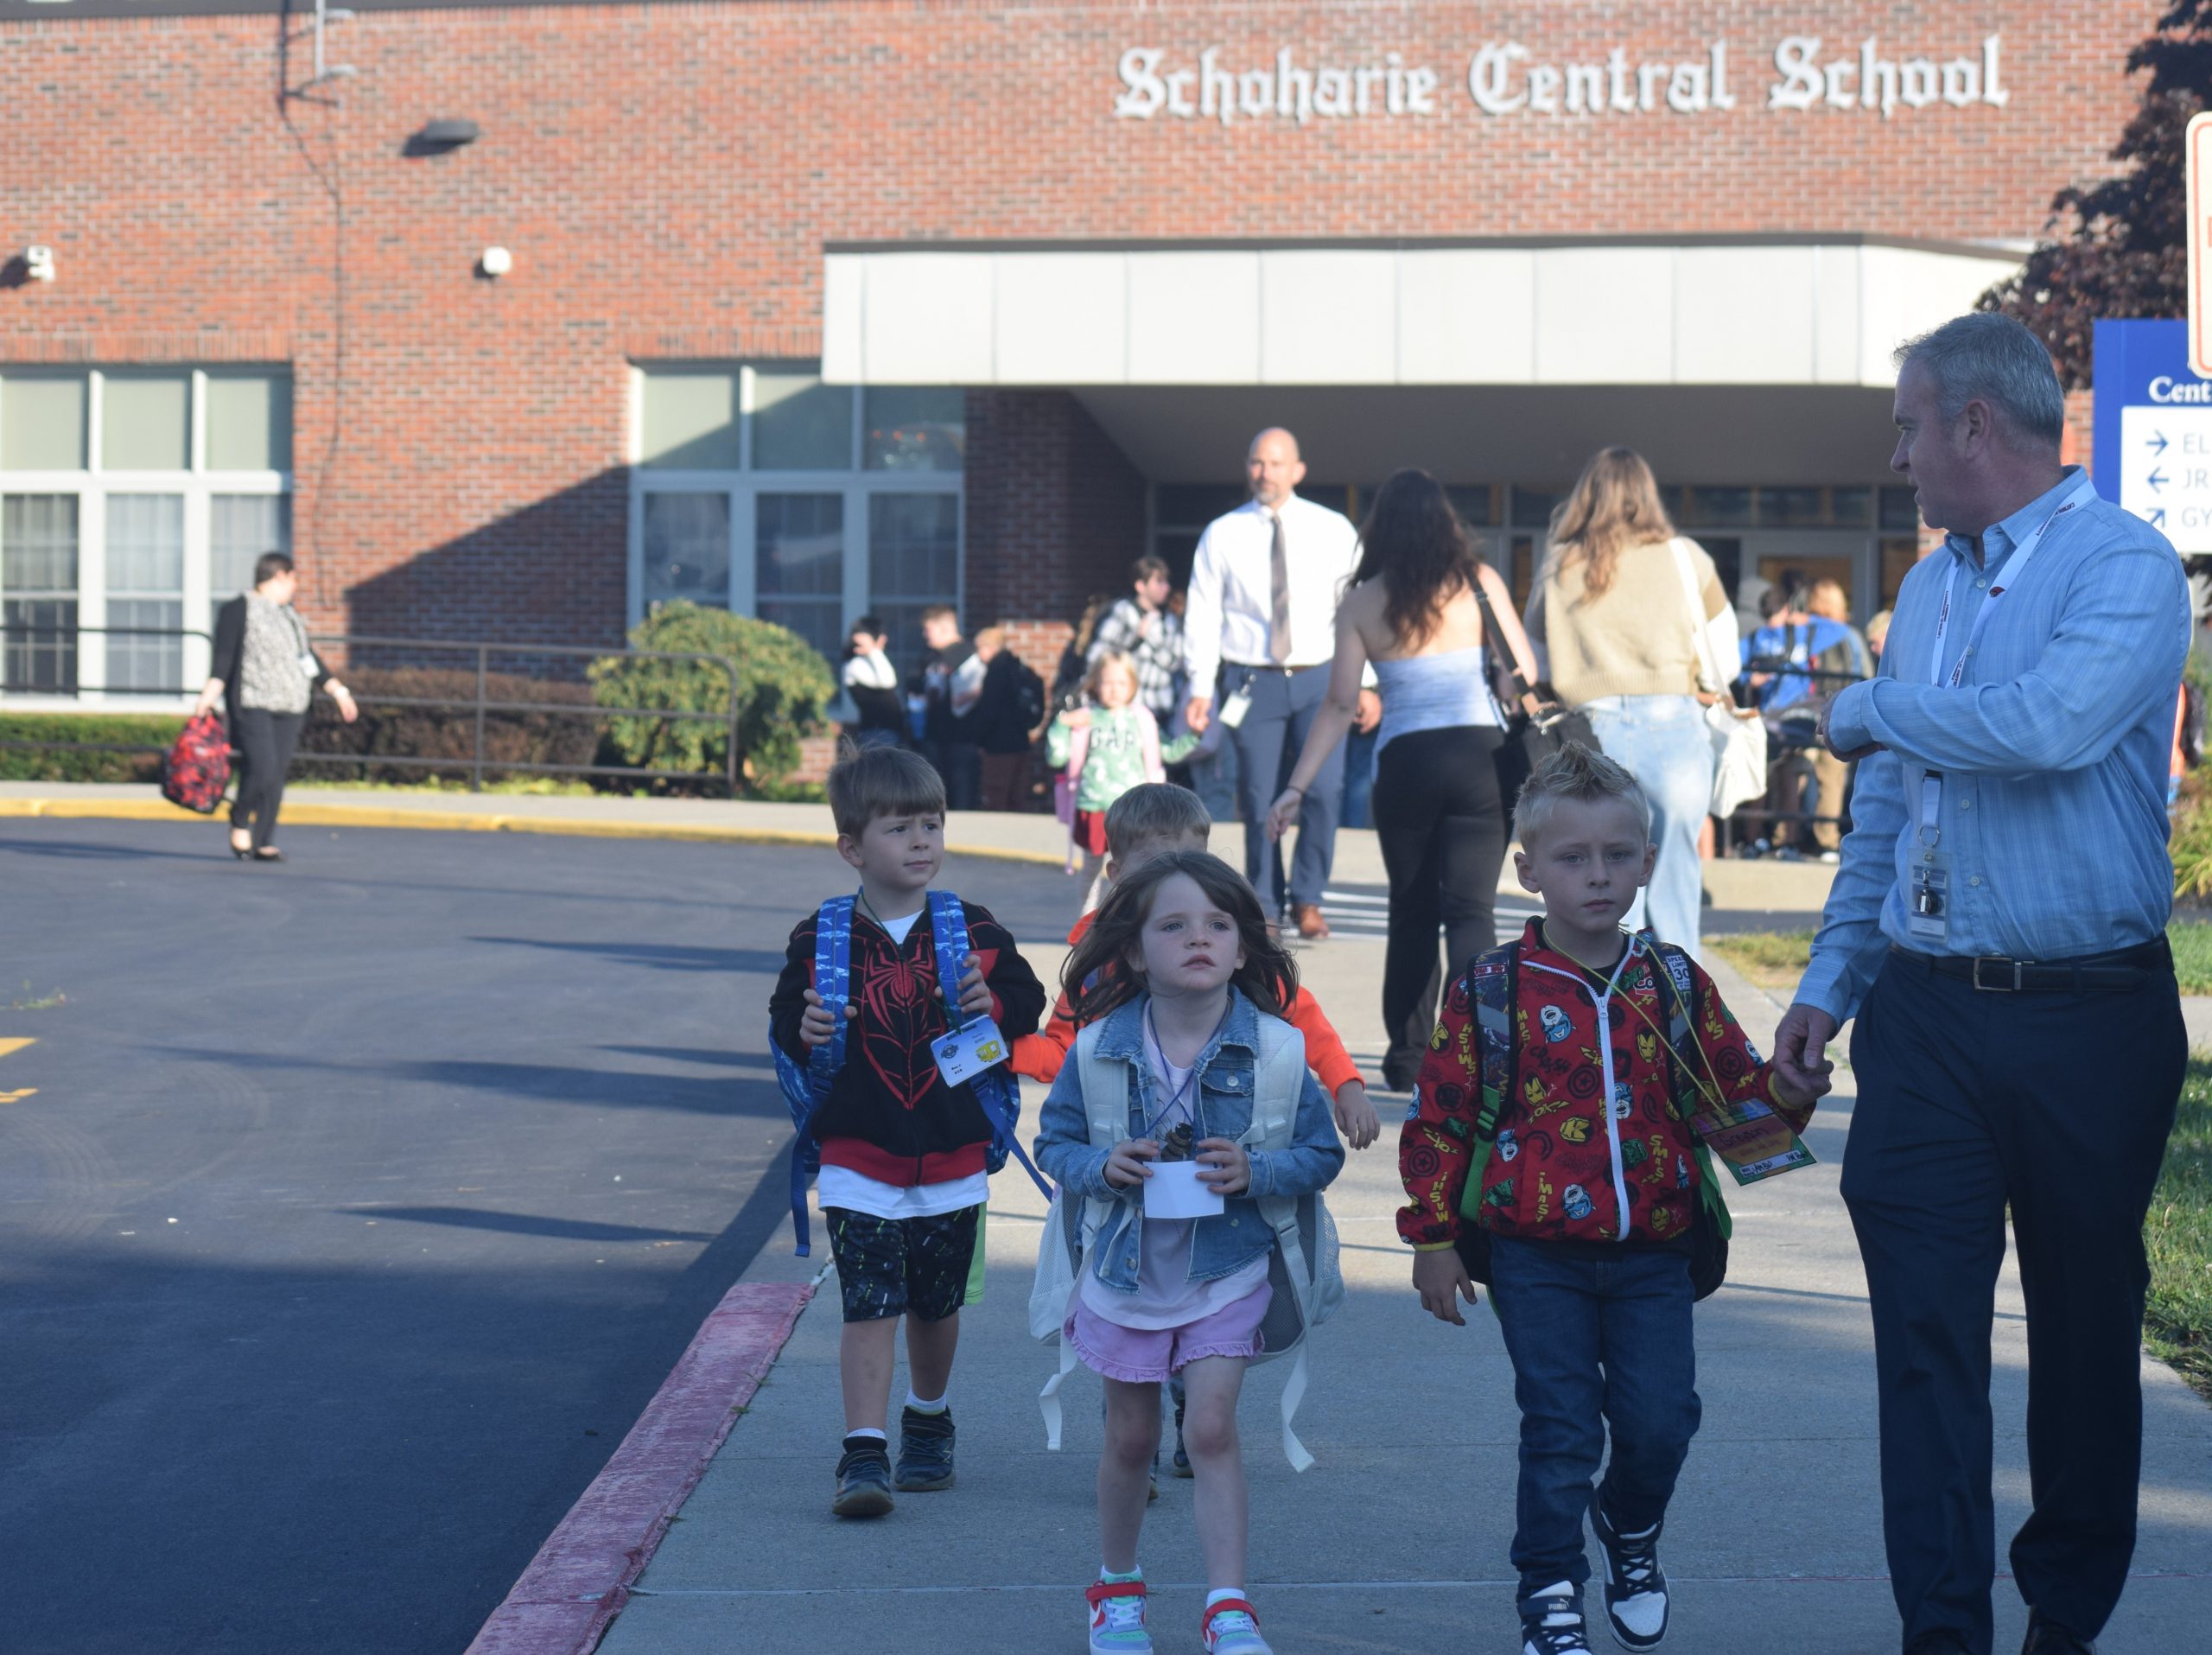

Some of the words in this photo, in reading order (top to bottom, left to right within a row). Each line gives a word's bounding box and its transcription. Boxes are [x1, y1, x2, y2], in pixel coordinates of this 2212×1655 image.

[1114, 46, 1438, 126] Schoharie
[1469, 37, 1736, 114] Central
[1768, 35, 2009, 119] School
